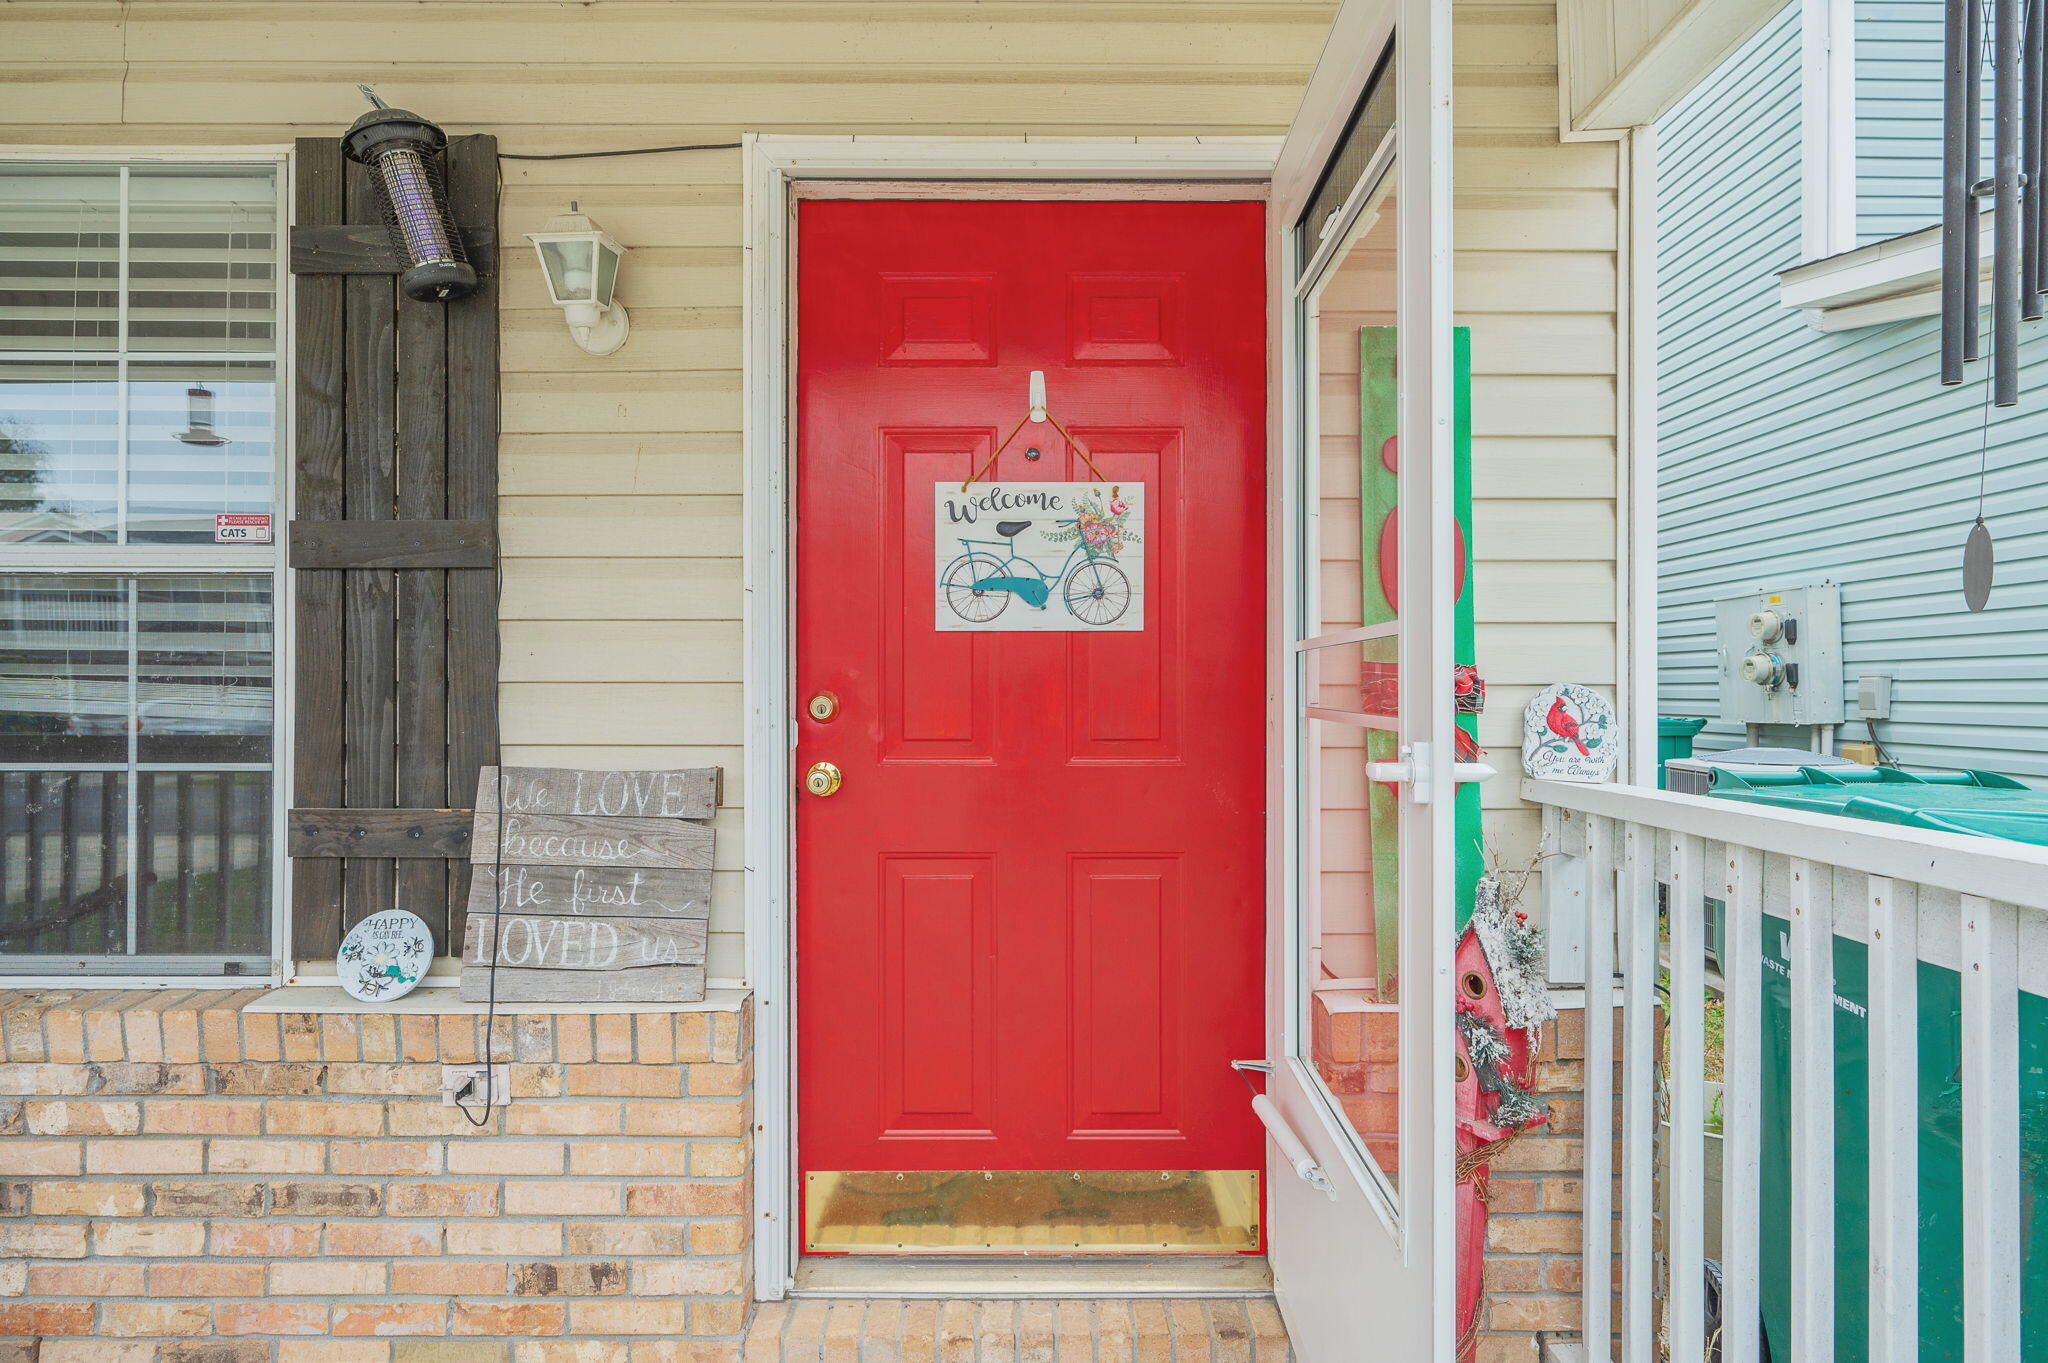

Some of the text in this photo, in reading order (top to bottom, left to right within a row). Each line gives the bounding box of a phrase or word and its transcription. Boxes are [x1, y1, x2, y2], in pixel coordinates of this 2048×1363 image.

[944, 487, 1064, 524] Welcome
[221, 528, 247, 537] CATS
[1542, 750, 1564, 767] You
[1567, 764, 1600, 779] Always
[491, 771, 686, 817] We LOVE
[491, 818, 652, 860] because
[488, 865, 655, 914] He first
[366, 918, 419, 929] HAPPY
[473, 917, 690, 967] LOVED us
[1761, 955, 1785, 975] ASTE
